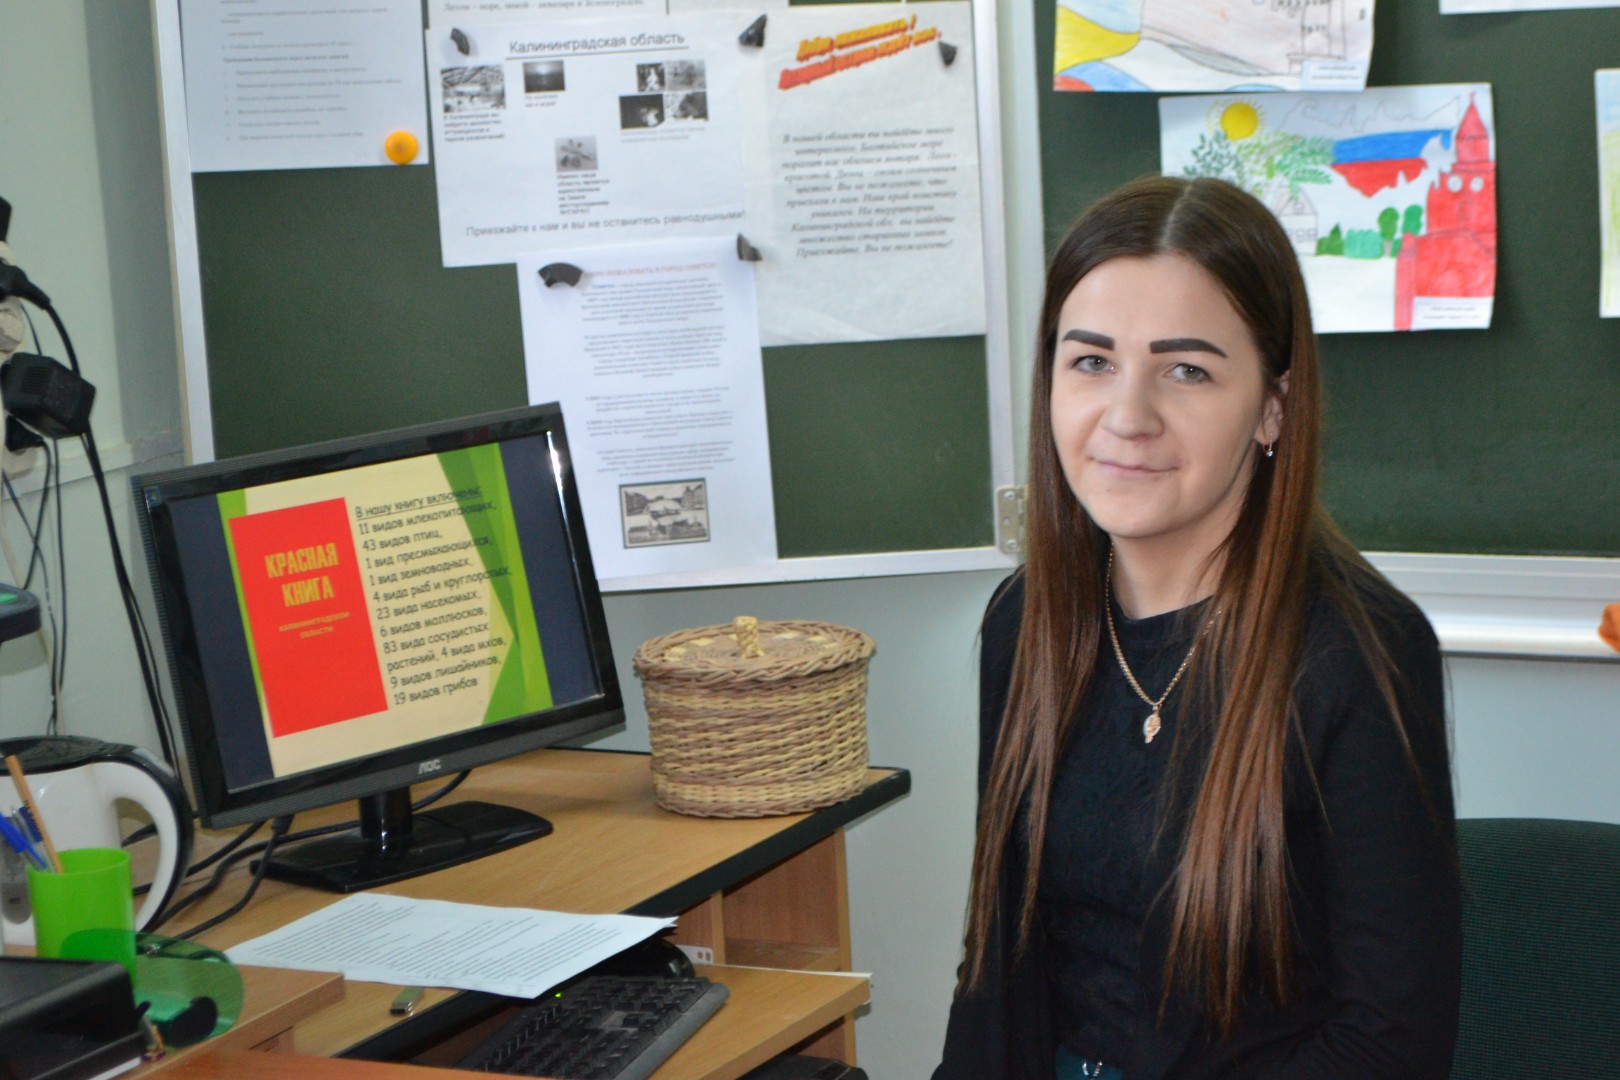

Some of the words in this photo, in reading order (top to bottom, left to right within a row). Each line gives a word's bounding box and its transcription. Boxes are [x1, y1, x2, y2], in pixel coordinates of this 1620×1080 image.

[509, 35, 626, 54] Калининградская
[630, 32, 685, 46] область
[466, 224, 529, 237] Приезжайте
[540, 222, 558, 231] нам
[588, 220, 600, 228] не
[355, 506, 363, 518] В
[366, 502, 392, 516] нашу
[394, 498, 424, 512] книгу
[358, 522, 370, 535] 11
[372, 518, 404, 533] видов
[362, 539, 376, 551] 43
[380, 536, 410, 550] видов
[414, 530, 442, 542] птиц,
[264, 542, 339, 579] КРАСНАЯ
[366, 557, 372, 569] 1
[374, 554, 394, 567] вид
[370, 574, 375, 586] 1
[378, 571, 398, 584] вид
[282, 576, 334, 608] КНИГА
[373, 591, 380, 602] 4
[383, 588, 409, 602] вида
[410, 581, 432, 596] рыб
[434, 582, 441, 590] и
[376, 606, 390, 620] 23
[394, 604, 418, 616] вида
[420, 590, 482, 610] насекомых,
[380, 626, 388, 638] 6
[390, 620, 422, 634] видов
[383, 640, 398, 655] 83
[400, 638, 426, 651] вида
[428, 623, 488, 644] сосудистых
[387, 650, 440, 674] растений,
[441, 646, 448, 658] 4
[450, 643, 476, 656] вида
[390, 677, 398, 688] 9
[400, 671, 432, 686] видов
[394, 692, 406, 706] 19
[409, 688, 441, 702] видов
[443, 678, 478, 694] грибов
[418, 758, 442, 774] AOC
